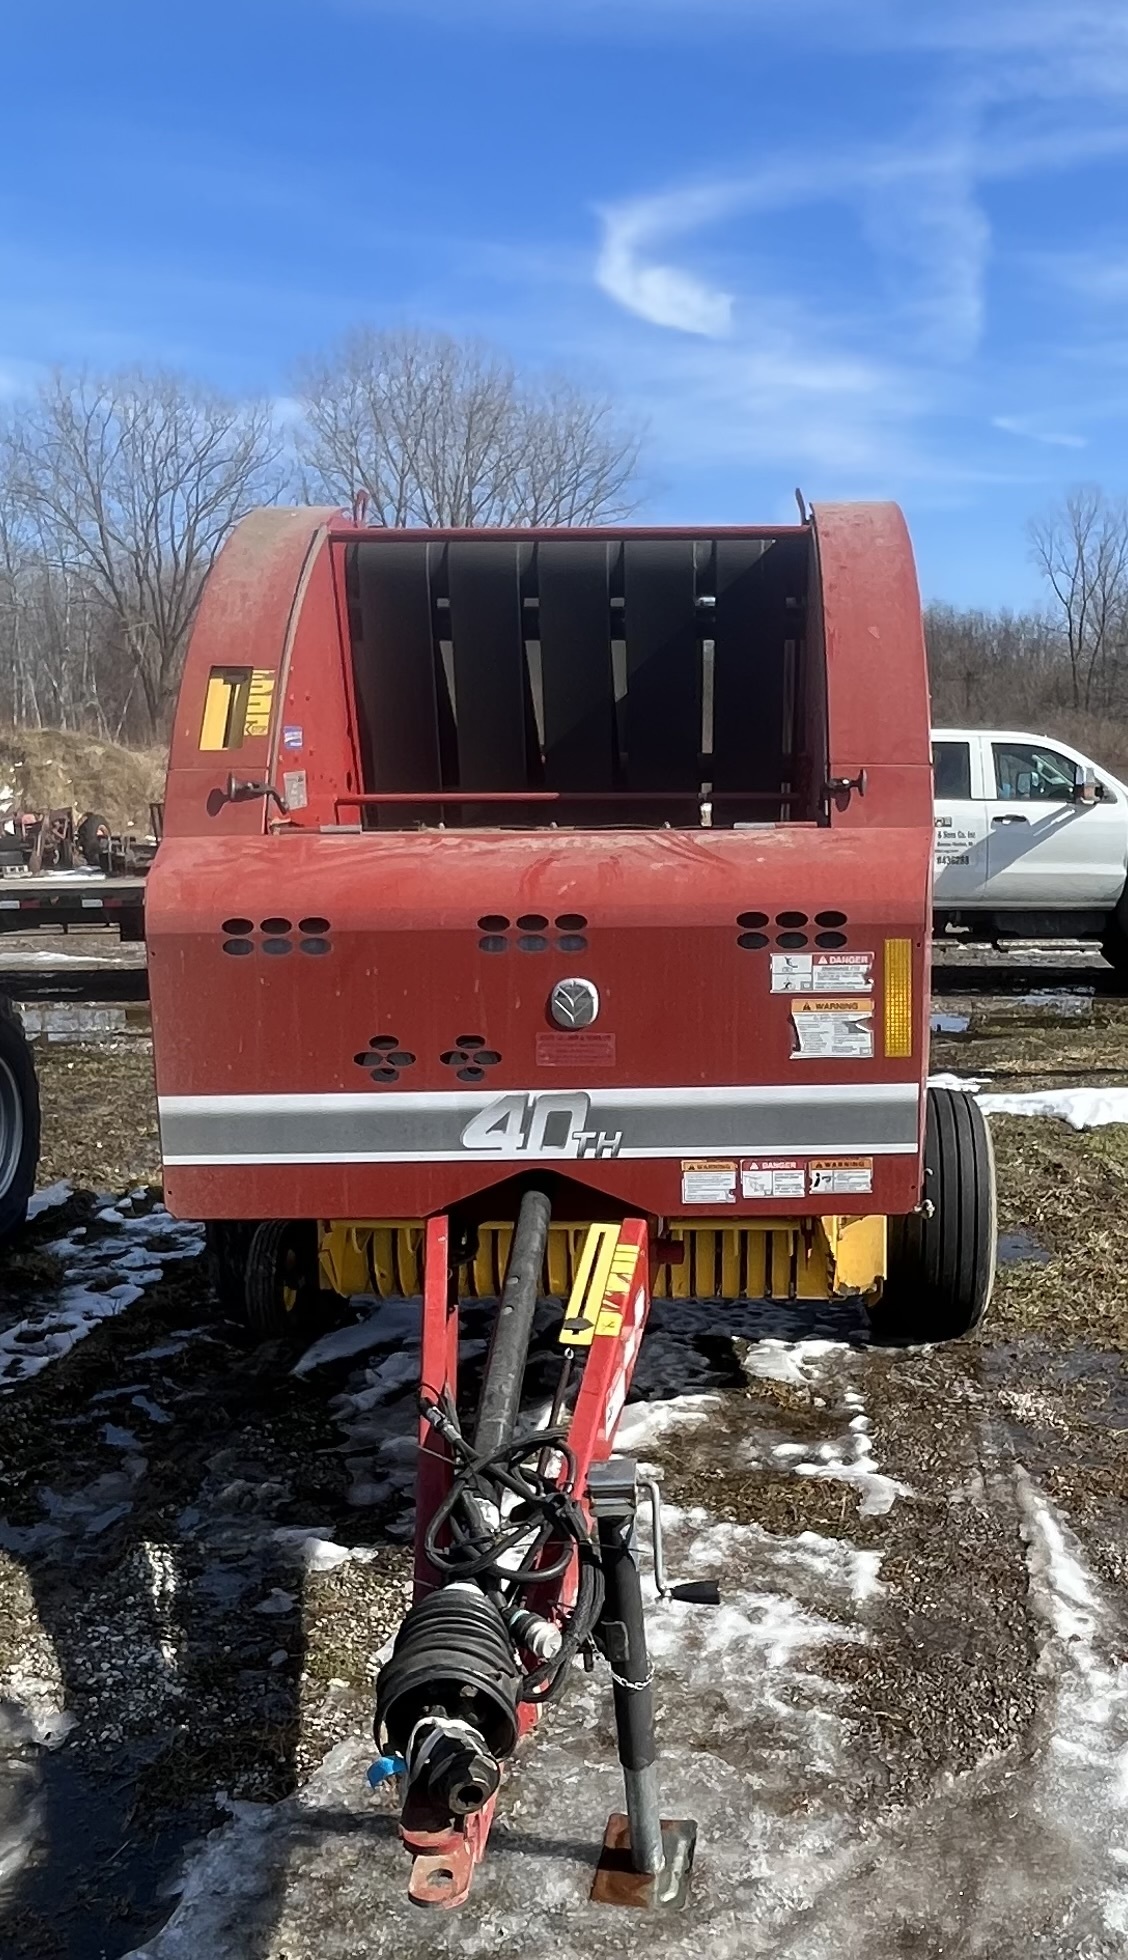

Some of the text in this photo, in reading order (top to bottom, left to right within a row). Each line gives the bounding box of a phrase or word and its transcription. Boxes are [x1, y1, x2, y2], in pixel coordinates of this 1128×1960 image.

[829, 955, 868, 965] DANGER
[815, 1002, 859, 1010] WARNING
[762, 1161, 797, 1170] DANGER
[824, 1160, 865, 1168] WARNING
